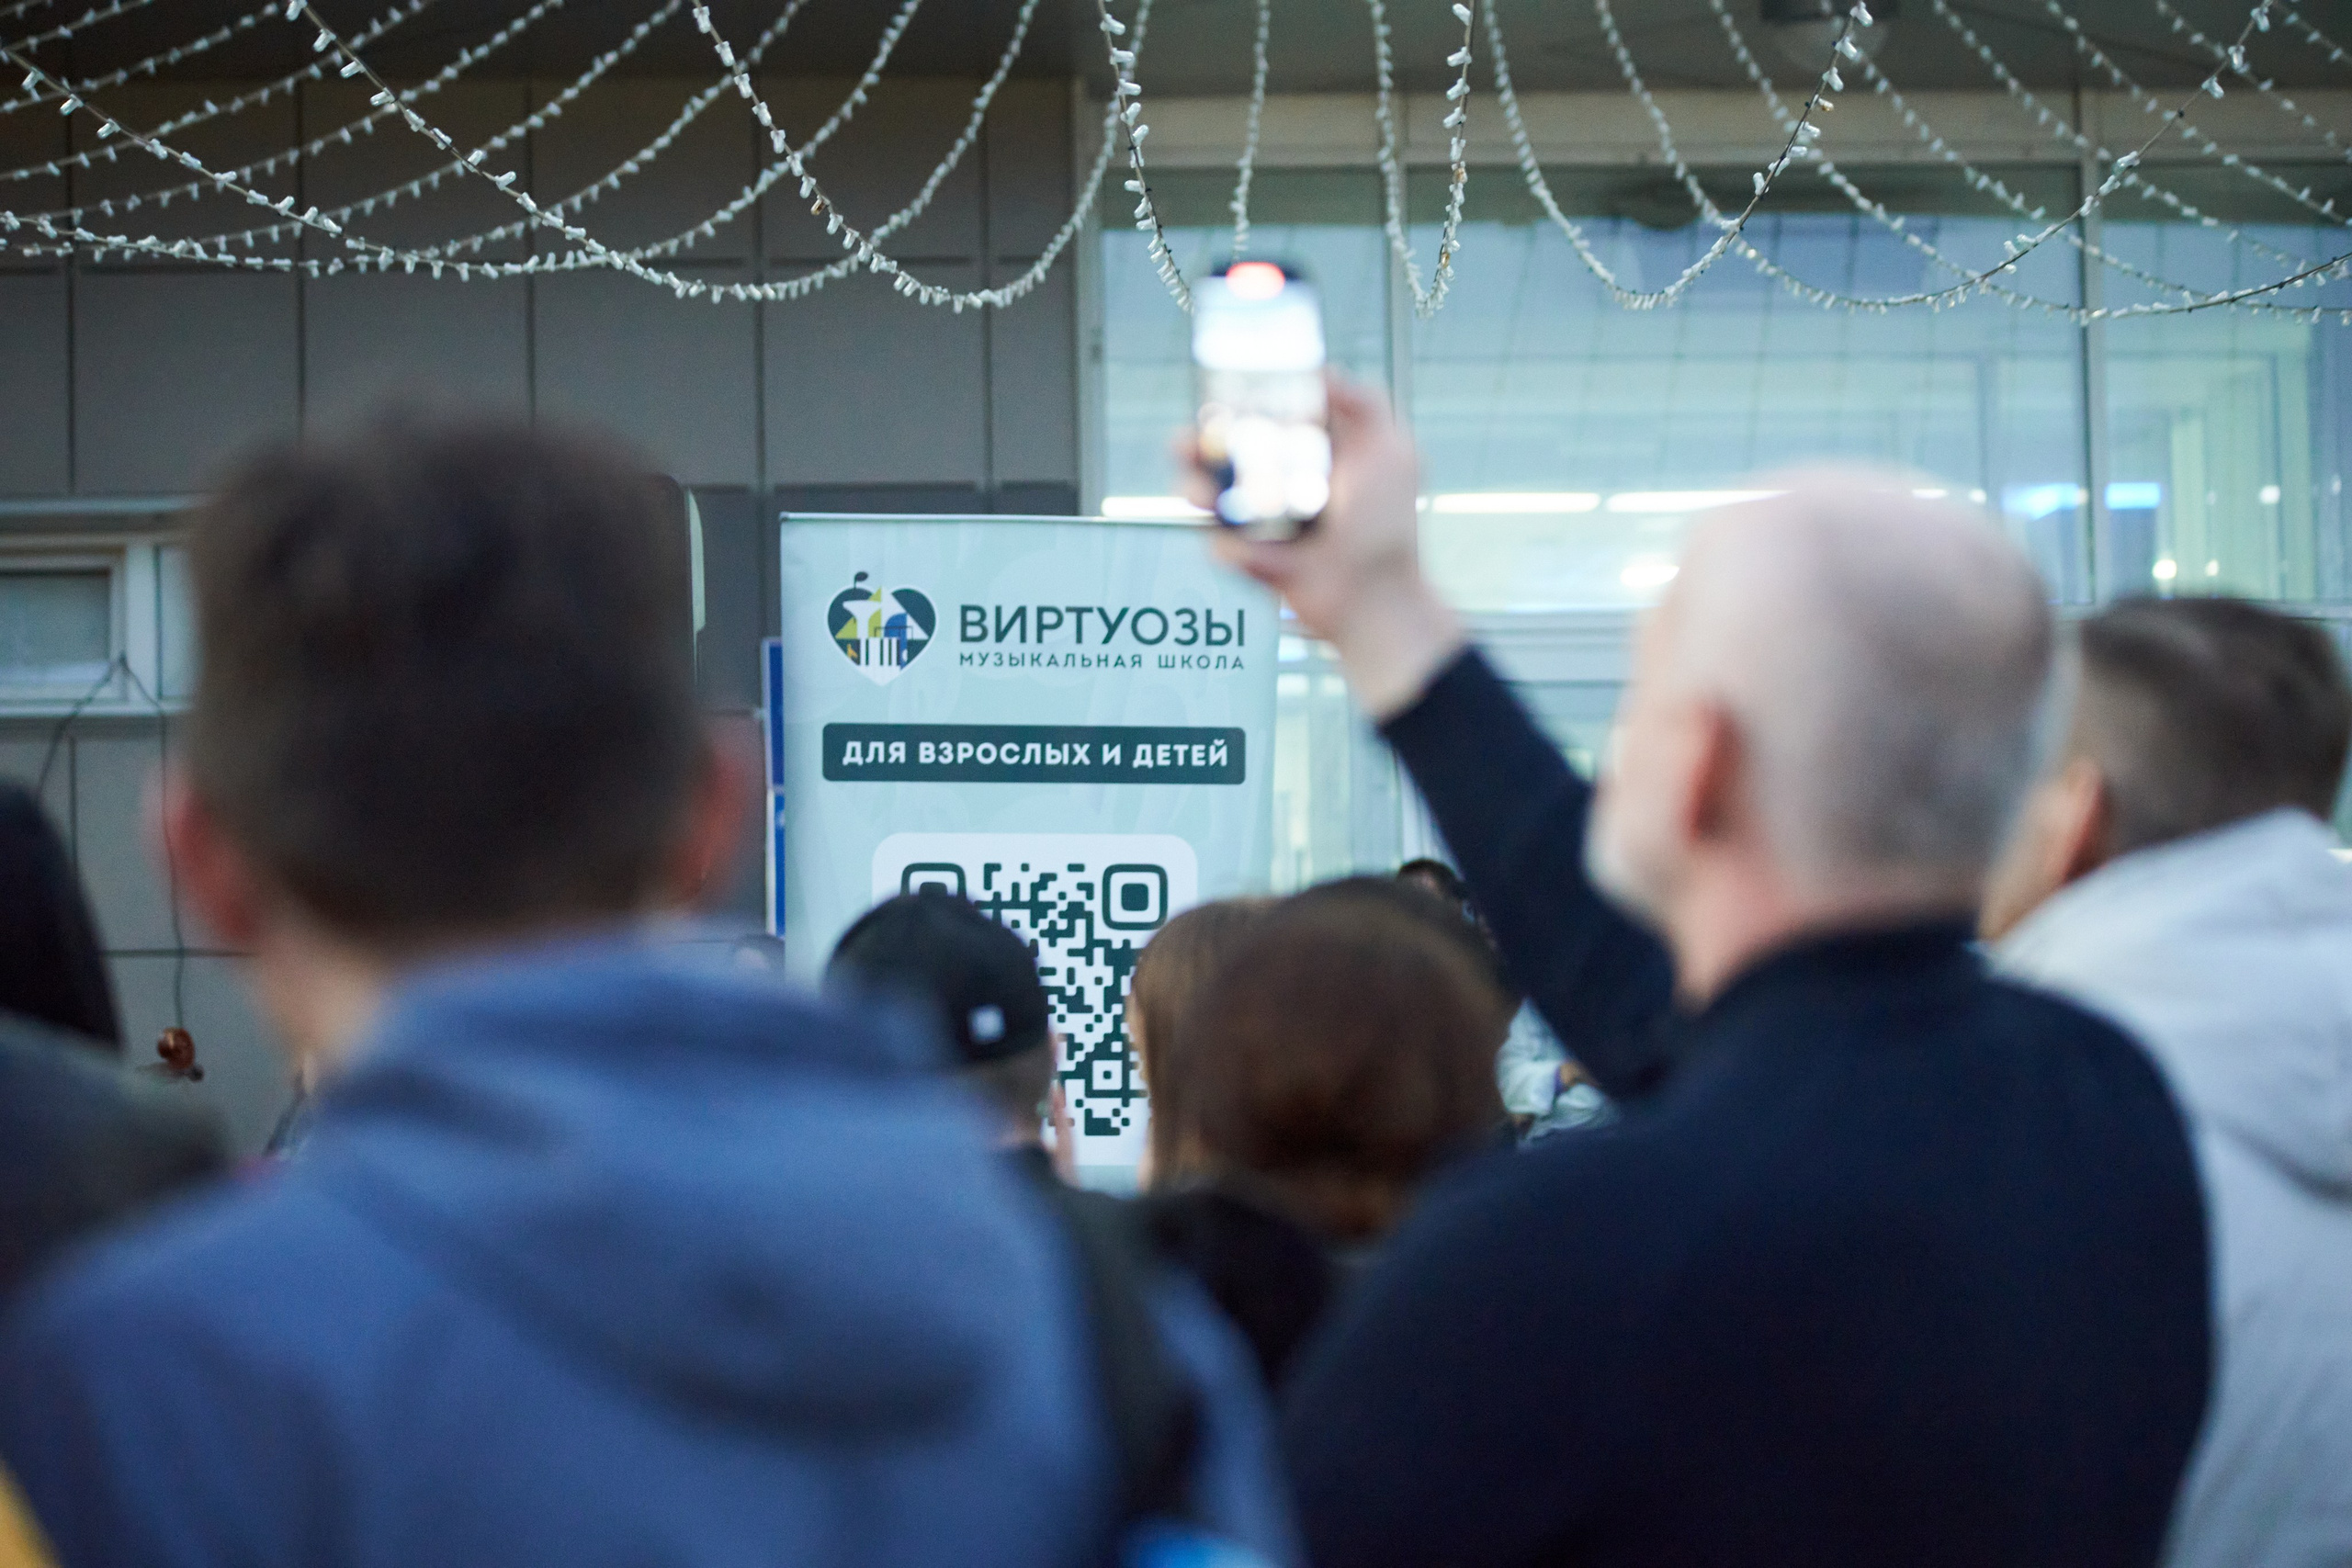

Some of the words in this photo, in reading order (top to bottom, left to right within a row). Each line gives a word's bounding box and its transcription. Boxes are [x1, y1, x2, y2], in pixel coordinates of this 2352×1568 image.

[960, 604, 1245, 647] ВИРТУОЗЫ
[959, 651, 1143, 669] МУЗЫКАЛЬНАЯ
[1158, 654, 1245, 670] ШКОЛА
[842, 740, 906, 766] ДЛЯ
[919, 741, 1091, 766] ВЗРОСЛЫХ
[1102, 744, 1122, 766] И
[1133, 739, 1228, 769] ДЕТЕЙ
